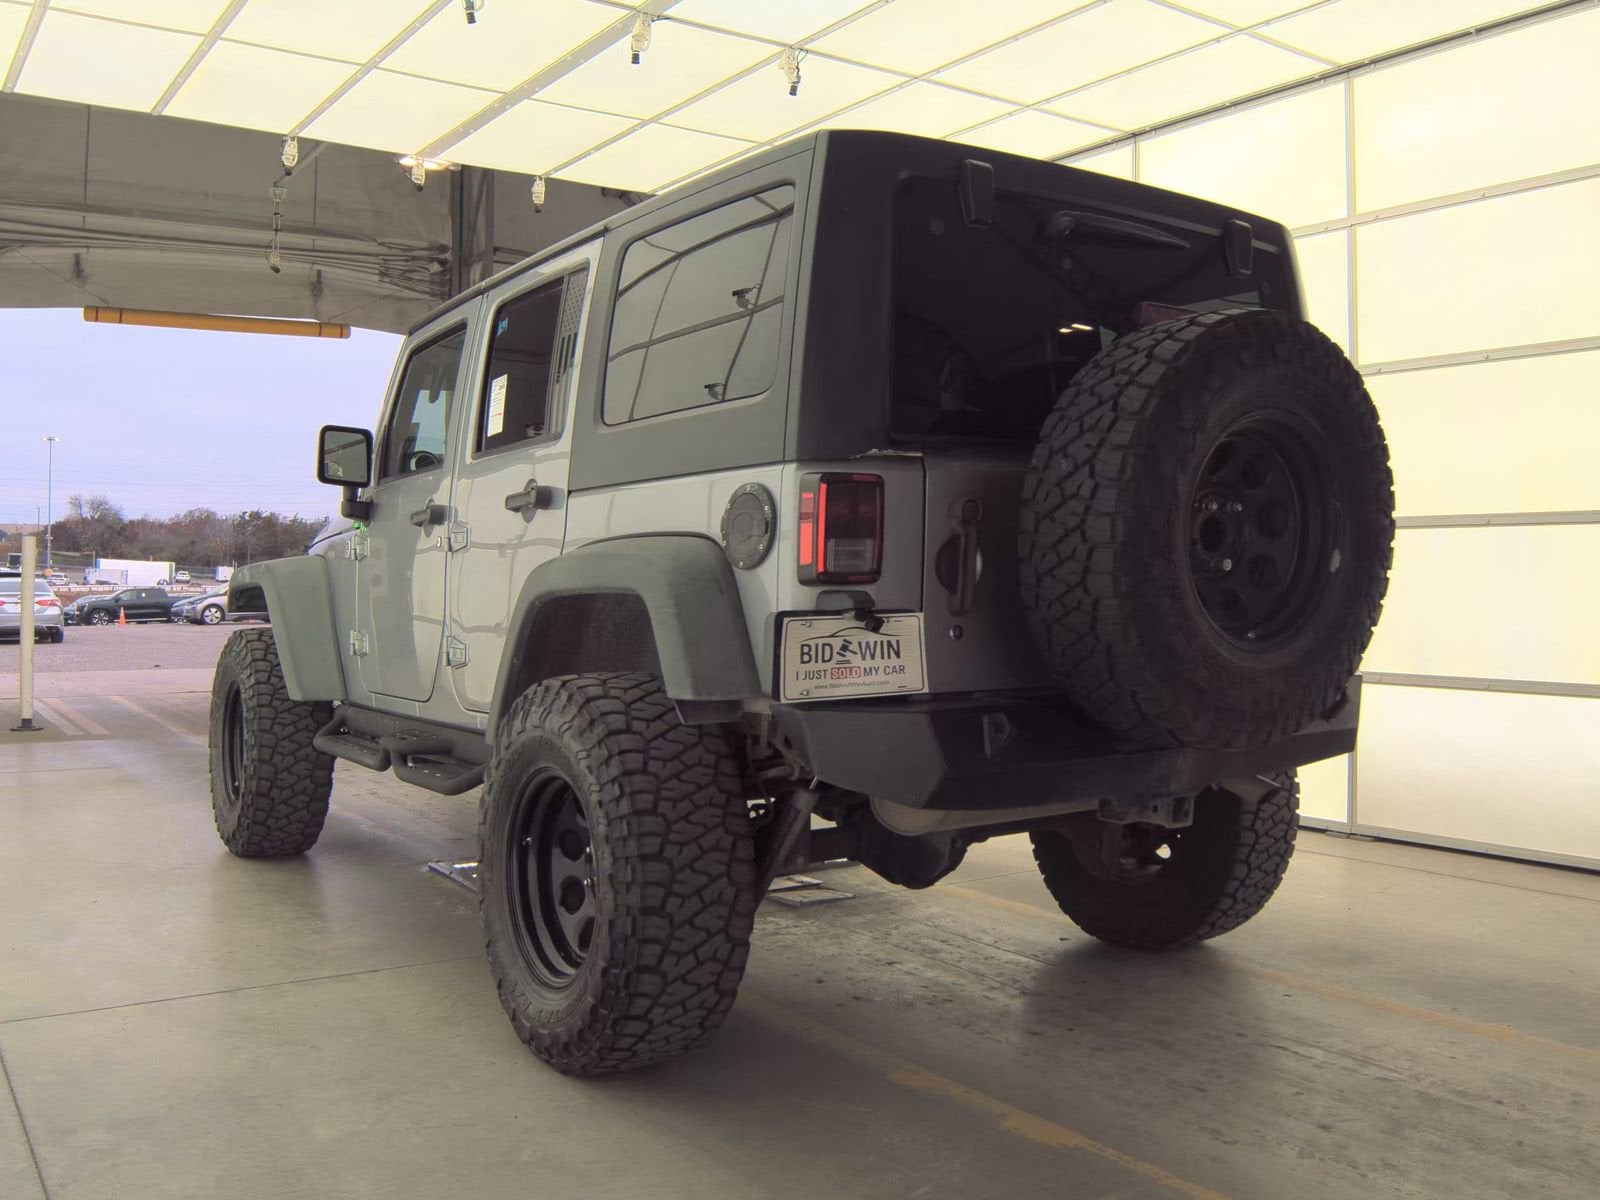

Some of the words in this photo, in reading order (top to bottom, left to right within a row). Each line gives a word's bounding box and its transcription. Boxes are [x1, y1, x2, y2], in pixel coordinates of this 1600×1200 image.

[800, 643, 834, 665] BID
[858, 639, 901, 661] WIN
[802, 669, 829, 681] JUST
[831, 667, 861, 680] SOLD
[863, 666, 880, 677] MY
[883, 665, 906, 675] CAR
